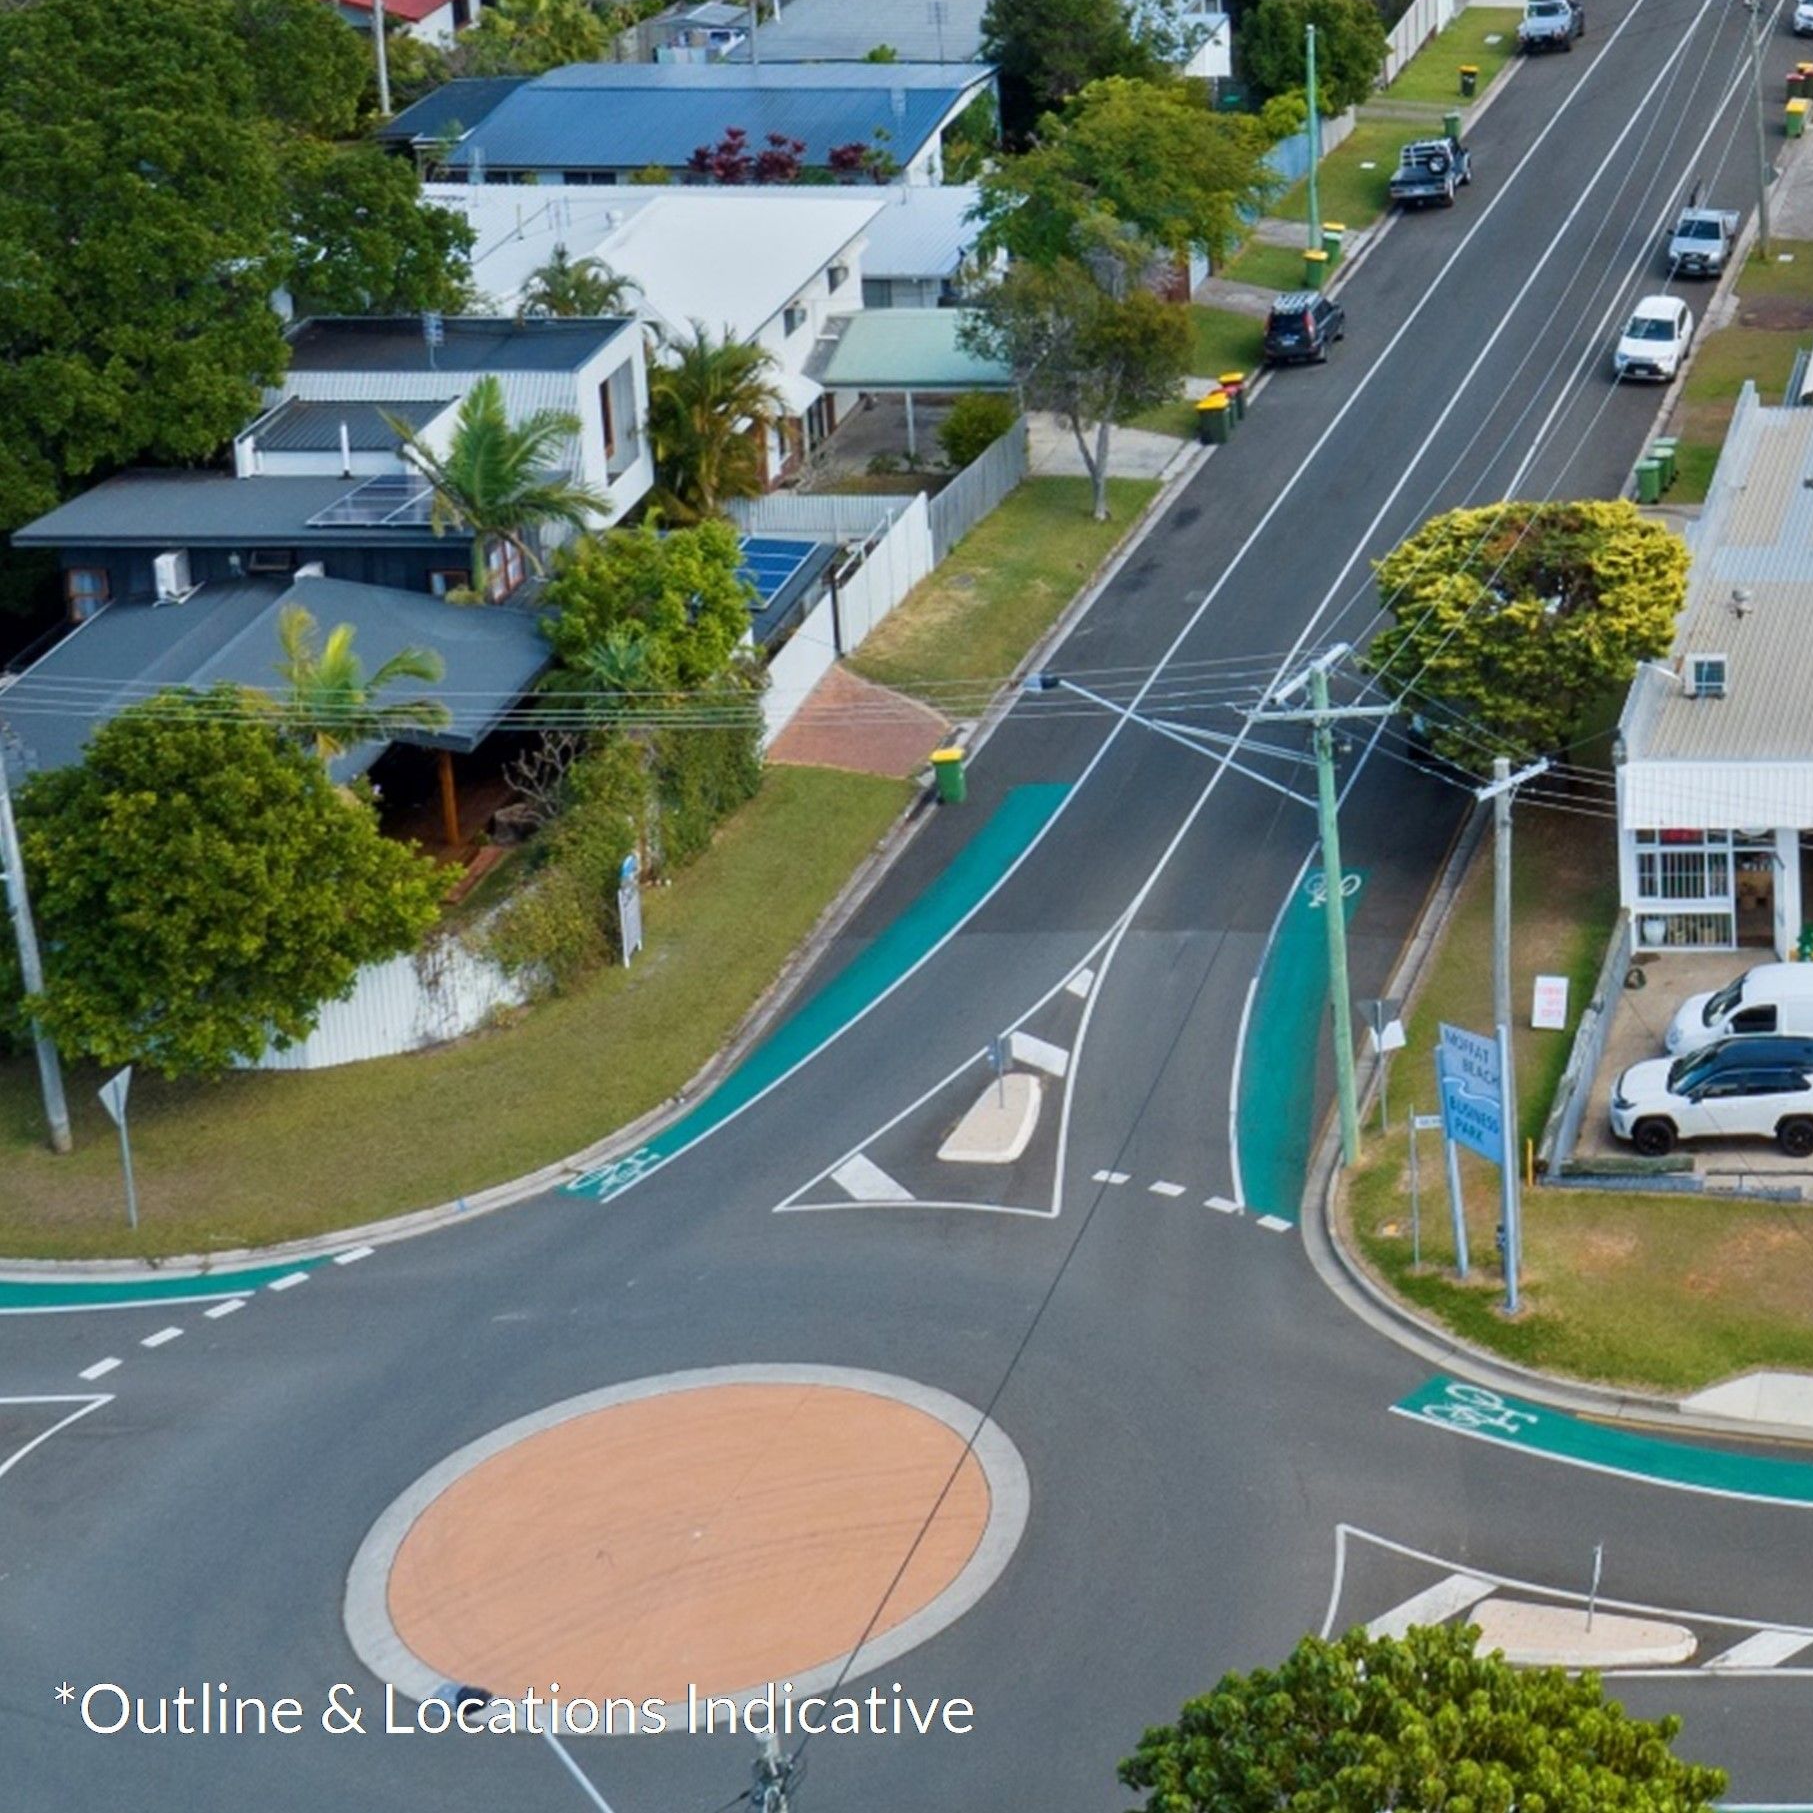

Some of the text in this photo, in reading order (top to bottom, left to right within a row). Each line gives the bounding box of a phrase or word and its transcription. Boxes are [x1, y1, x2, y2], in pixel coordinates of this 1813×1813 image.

[1445, 1029, 1490, 1064] MOFFAT
[1462, 1058, 1500, 1086] BEACH
[1450, 1095, 1500, 1135] BUSINESS
[1454, 1117, 1485, 1143] PARK
